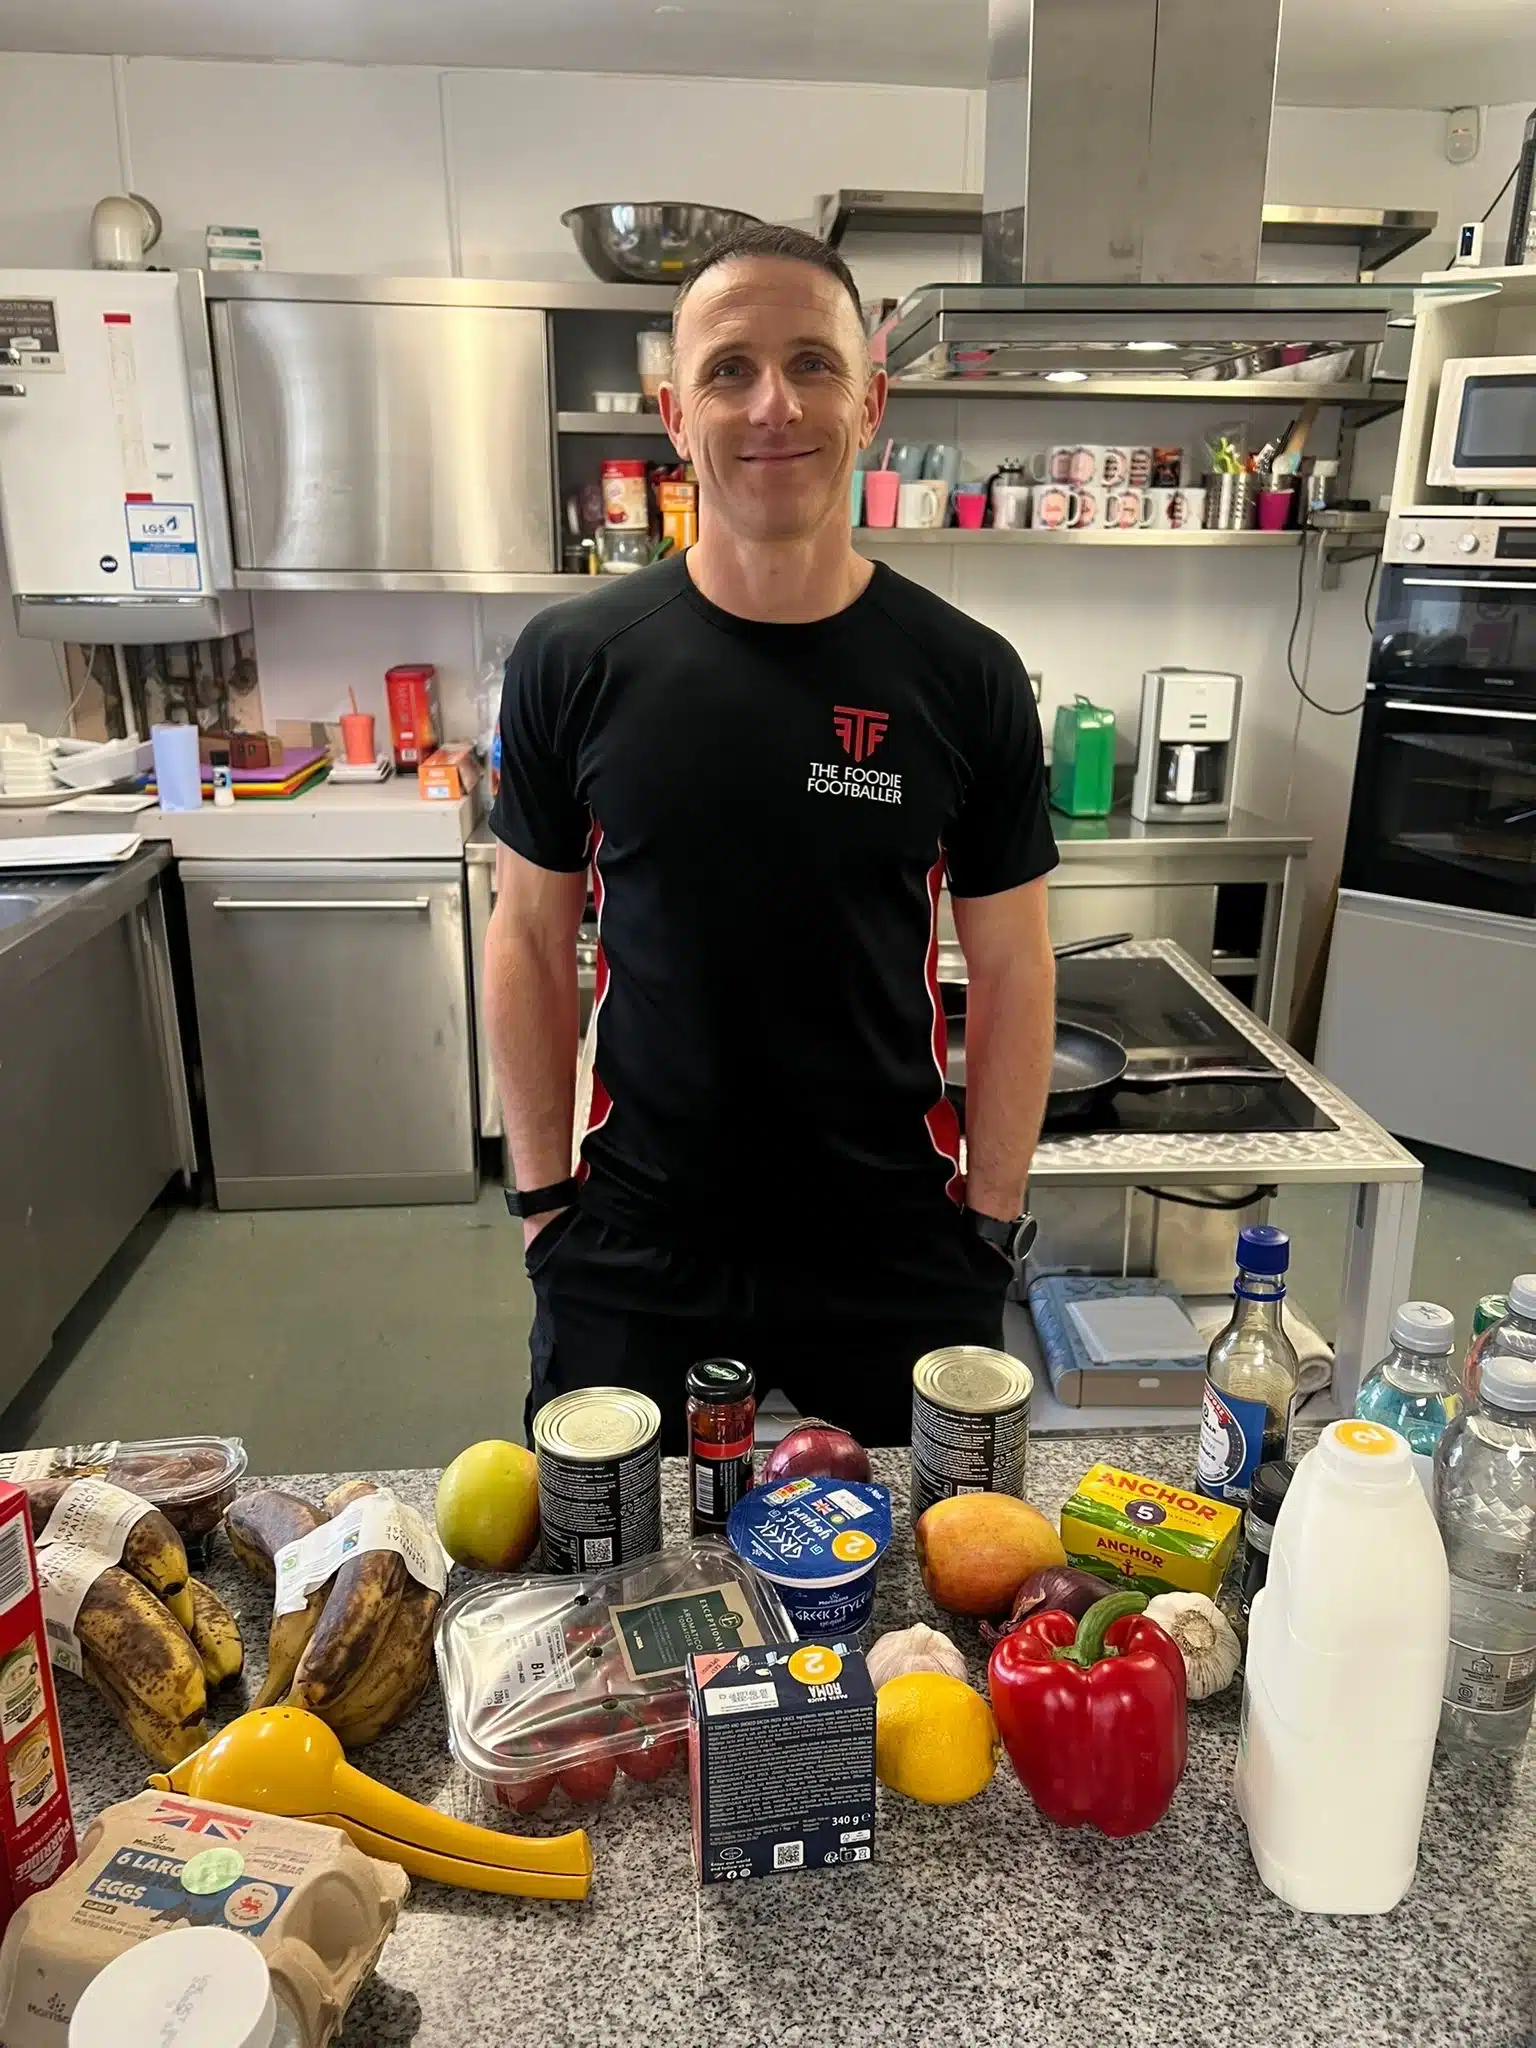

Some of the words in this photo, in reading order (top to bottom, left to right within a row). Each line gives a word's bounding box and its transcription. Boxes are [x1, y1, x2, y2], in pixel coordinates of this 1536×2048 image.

[142, 524, 165, 534] LGS
[810, 762, 839, 779] THE
[844, 766, 902, 789] FOODIE
[807, 778, 902, 804] FOOTBALLER
[1352, 1428, 1385, 1444] 2
[1097, 1472, 1218, 1521] ANCHOR
[63, 1487, 99, 1542] WAITRO
[787, 1507, 834, 1540] yogurt
[1136, 1505, 1154, 1520] 5
[755, 1520, 803, 1559] GREEK
[776, 1514, 815, 1545] STYLE
[1115, 1520, 1157, 1538] BUTTER
[844, 1536, 867, 1554] 2
[1096, 1537, 1164, 1568] ANCHOR
[795, 1610, 831, 1621] GREEK
[834, 1597, 866, 1619] STYLE
[678, 1615, 693, 1647] TOMATOES
[682, 1608, 704, 1651] AROMATICO
[803, 1652, 825, 1674] 2
[807, 1682, 843, 1699] ROMA
[807, 1696, 827, 1704] SAUCE
[830, 1694, 849, 1702] PASTA
[832, 1815, 851, 1826] 340
[852, 1815, 859, 1826] g
[15, 1818, 71, 1882] PORRIDGE
[116, 1852, 131, 1865] 6
[133, 1855, 186, 1878] LARG
[93, 1877, 148, 1900] EGGS
[28, 2003, 70, 2025] Morriso
